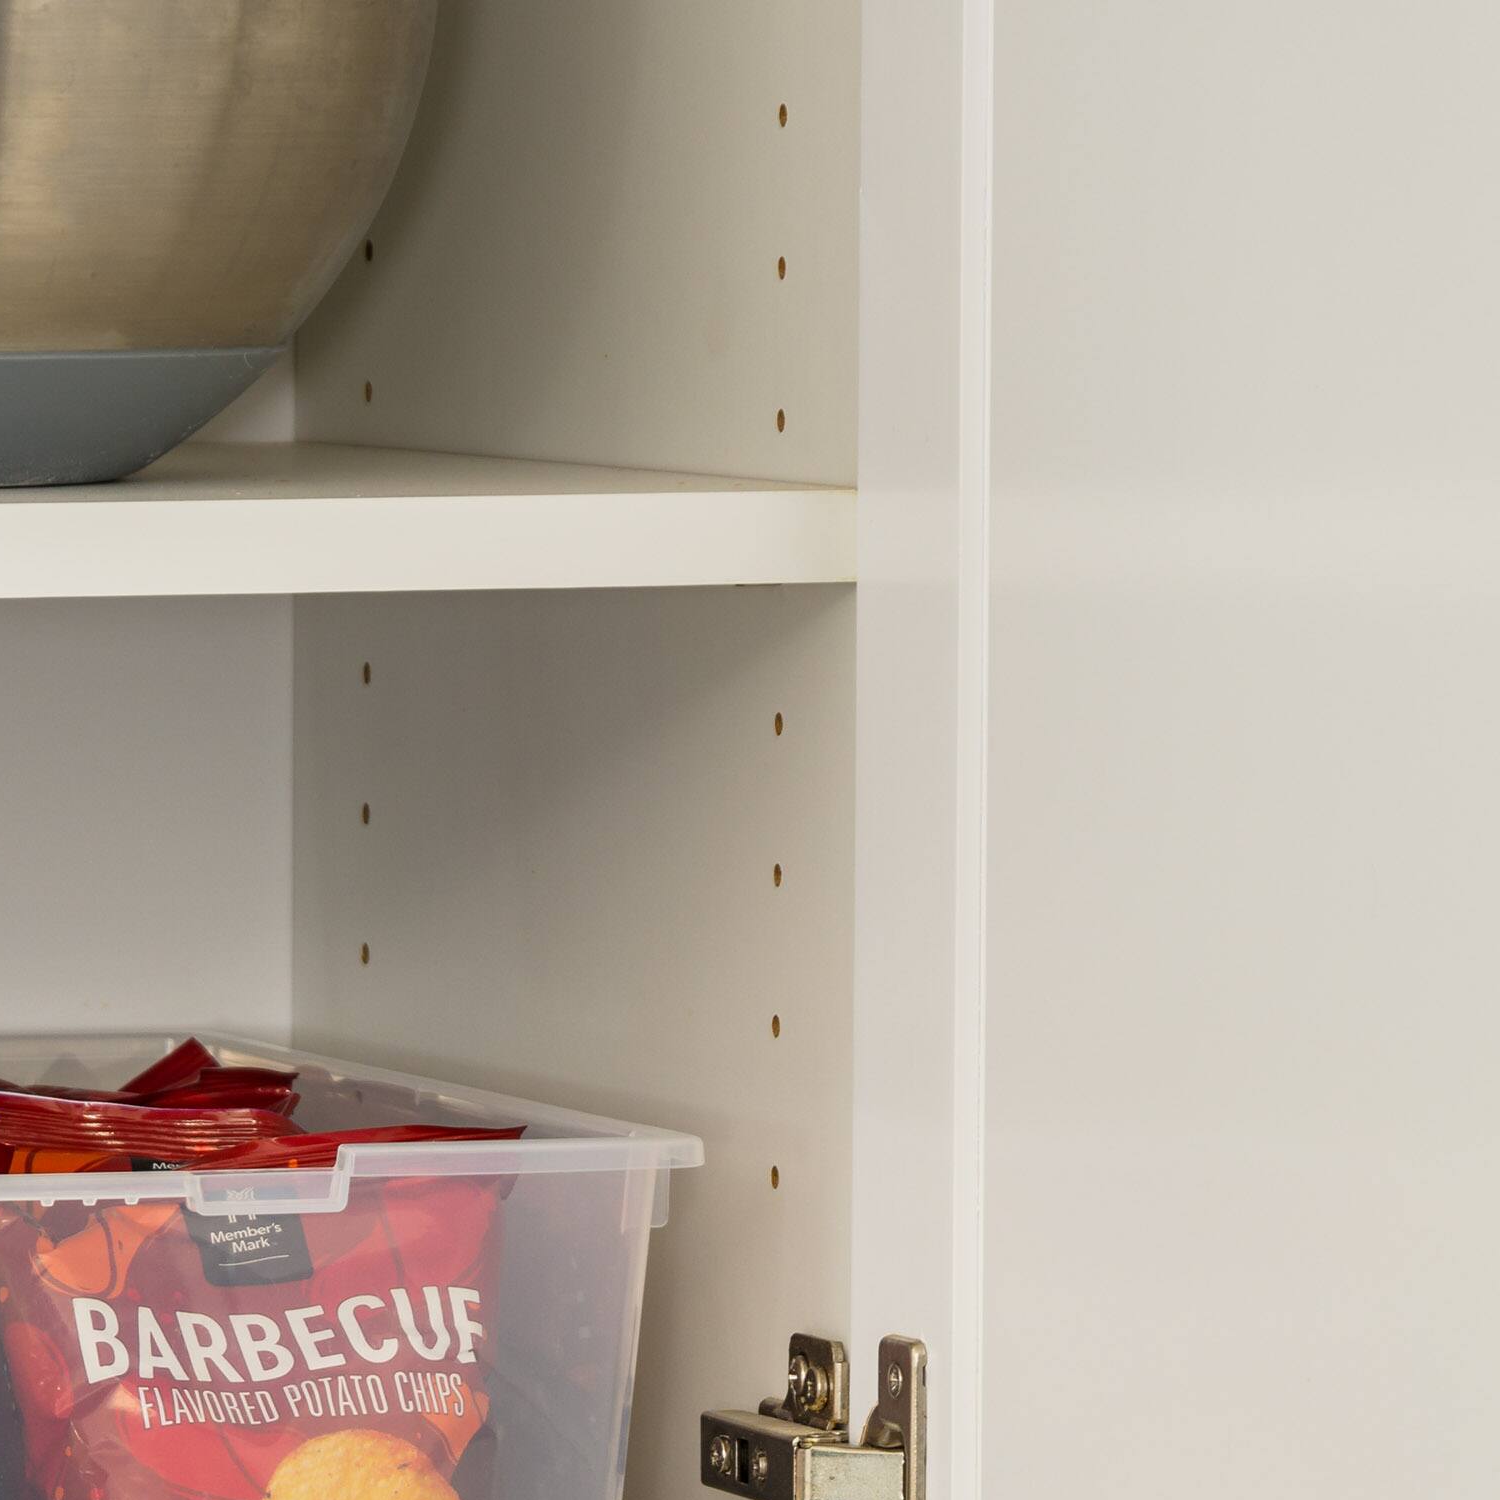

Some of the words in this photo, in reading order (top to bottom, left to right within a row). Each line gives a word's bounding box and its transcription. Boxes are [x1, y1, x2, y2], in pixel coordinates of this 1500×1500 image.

[210, 1222, 283, 1245] Member's
[232, 1236, 271, 1254] Mark
[137, 1384, 280, 1430] FLAVORED
[282, 1373, 391, 1420] POTATO
[392, 1370, 466, 1418] CHIPS
